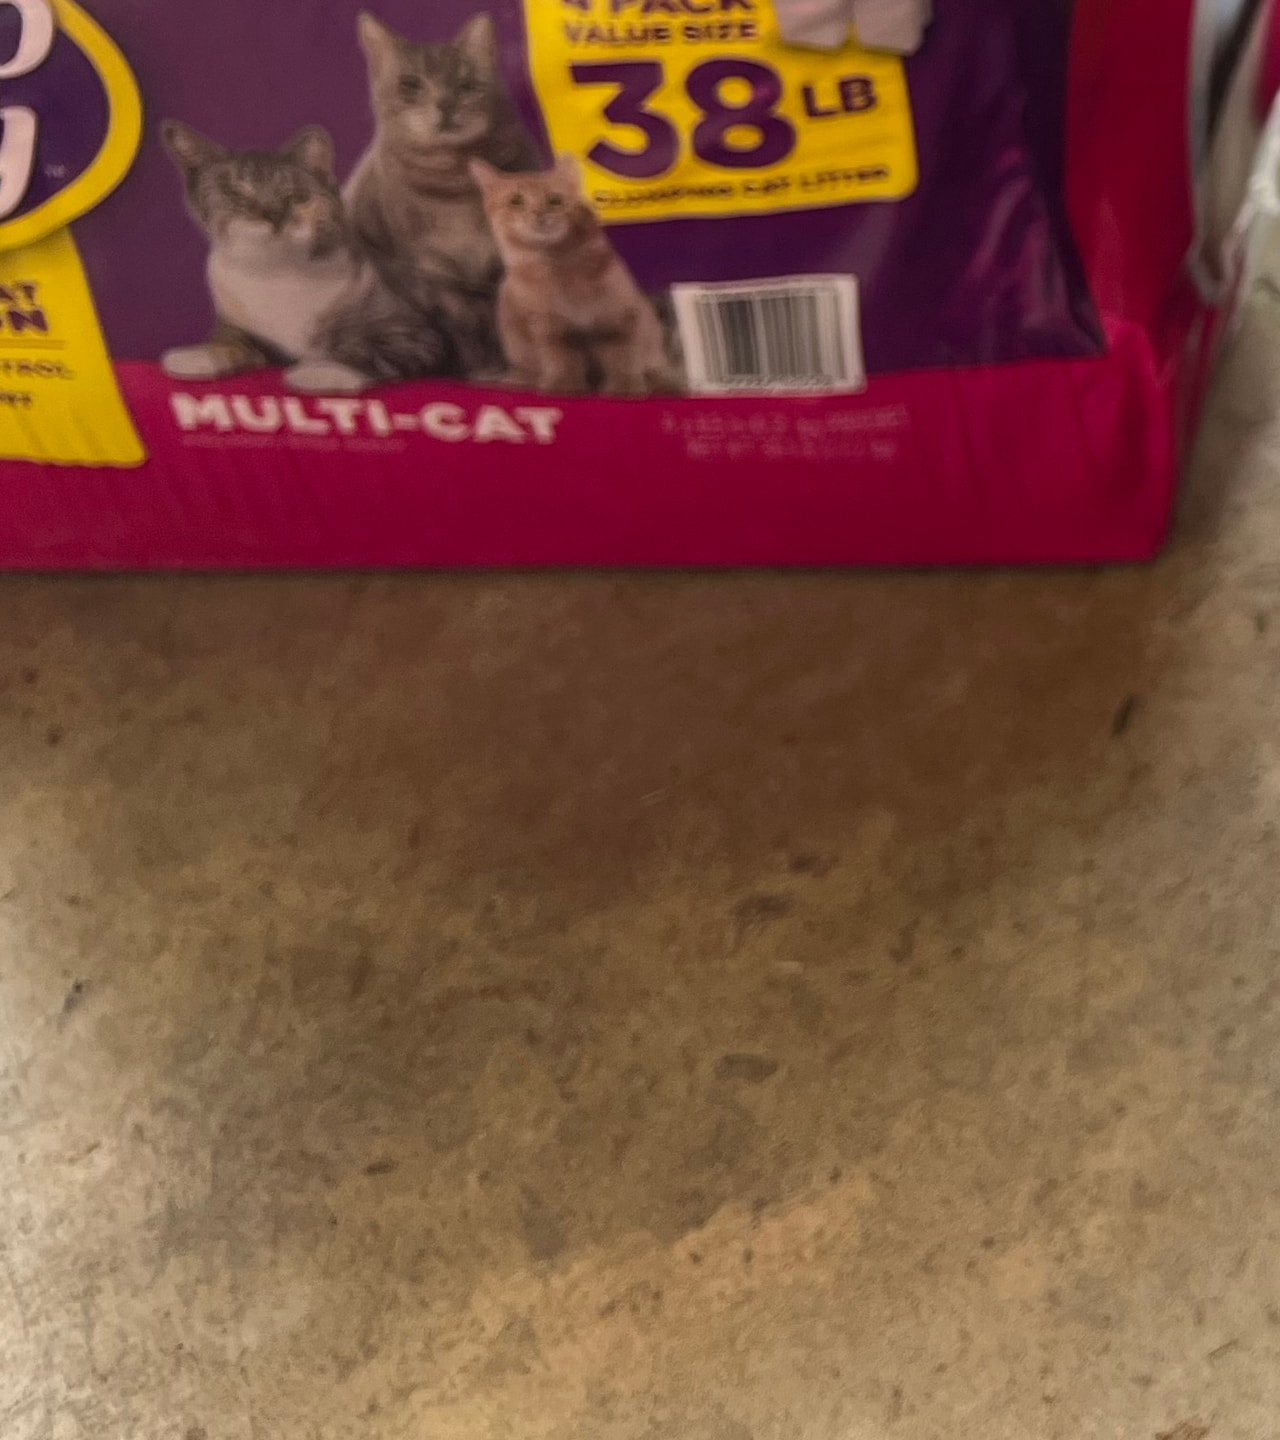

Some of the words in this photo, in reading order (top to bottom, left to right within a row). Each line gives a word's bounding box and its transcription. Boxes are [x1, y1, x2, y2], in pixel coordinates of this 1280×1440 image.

[563, 22, 672, 45] VALUE
[569, 59, 797, 180] 38
[802, 76, 878, 119] LB
[170, 392, 562, 444] MULTI-CAT
